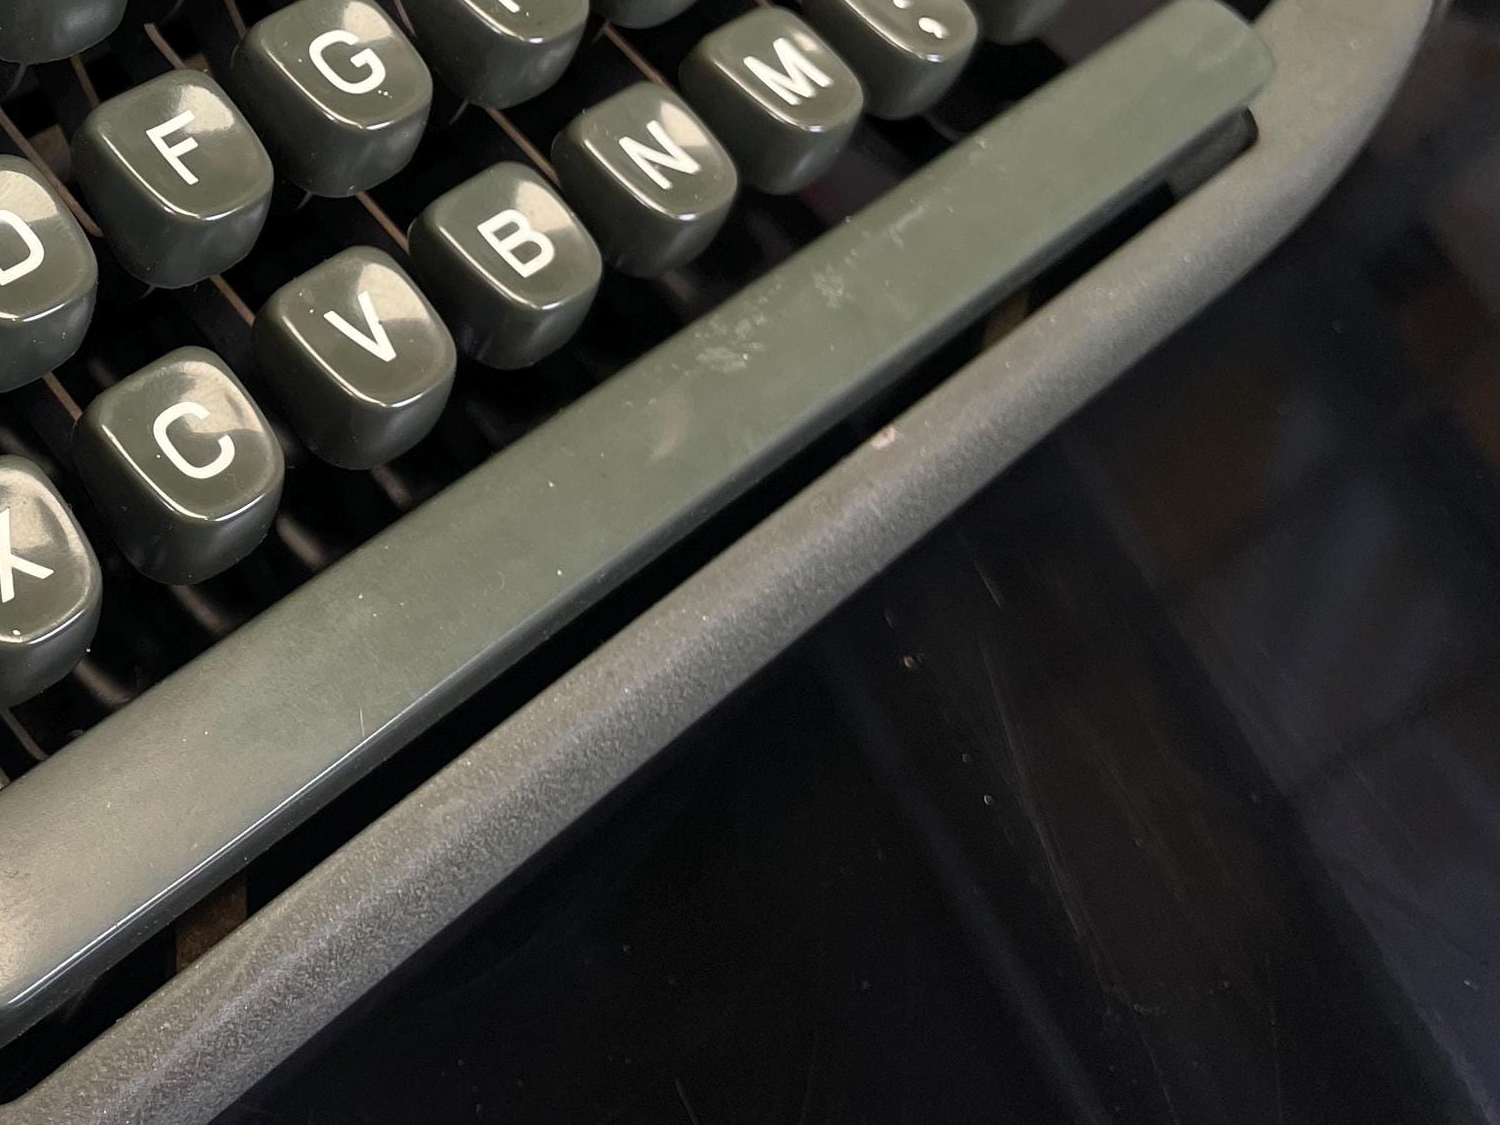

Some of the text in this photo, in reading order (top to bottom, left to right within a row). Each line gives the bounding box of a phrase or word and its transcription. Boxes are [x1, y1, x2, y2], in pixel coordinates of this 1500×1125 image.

[309, 30, 386, 94] G
[744, 38, 830, 104] M
[146, 111, 198, 186] F
[619, 121, 700, 190] N
[478, 209, 555, 278] B
[324, 292, 397, 362] V
[153, 402, 238, 479] C
